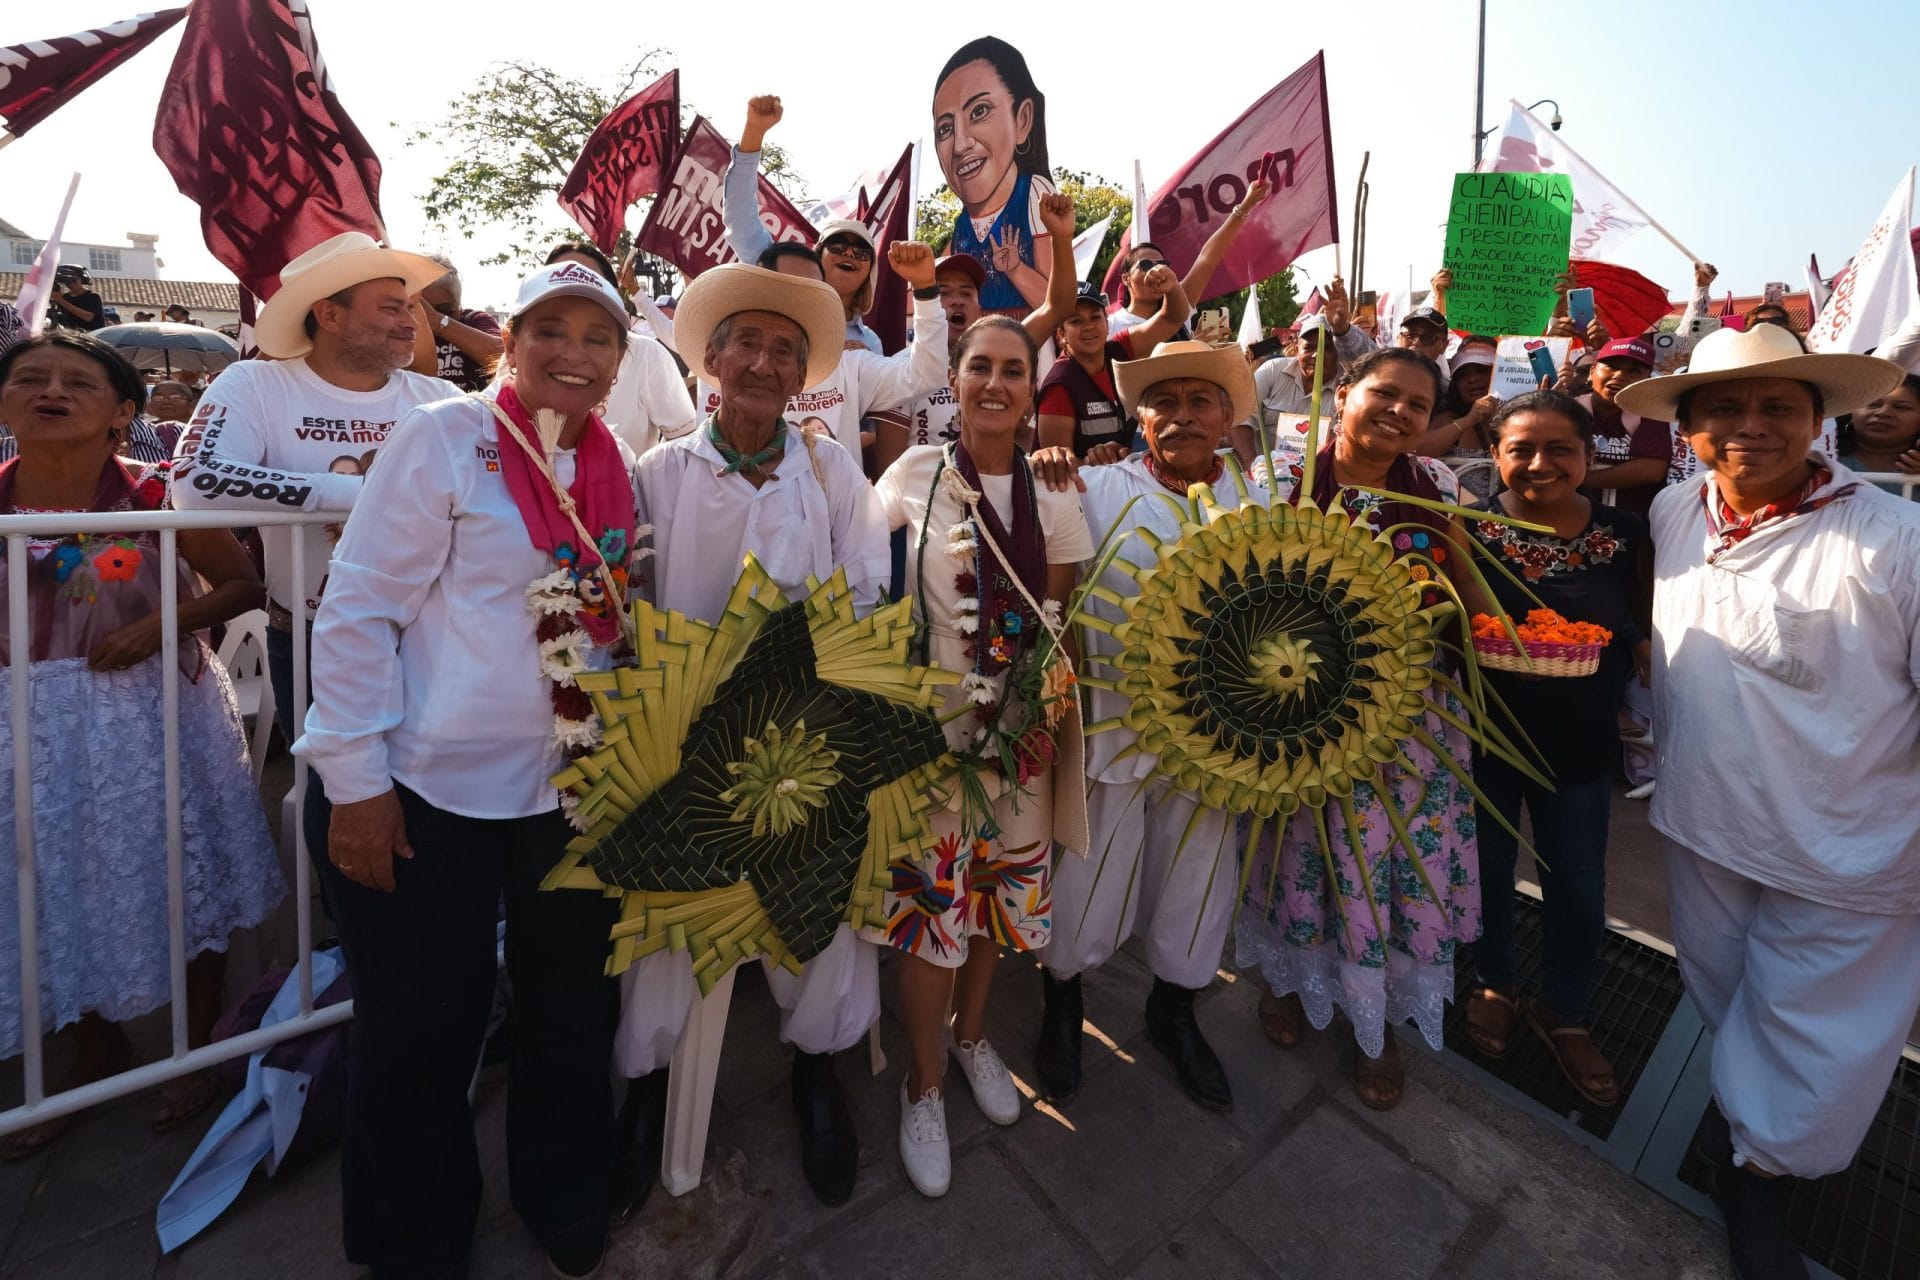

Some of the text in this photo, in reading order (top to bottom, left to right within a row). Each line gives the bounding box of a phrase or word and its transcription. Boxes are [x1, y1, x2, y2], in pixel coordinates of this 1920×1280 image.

[1460, 175, 1567, 202] CLAUDIA
[1446, 247, 1561, 266] LA ASOCIACION
[1502, 264, 1514, 272] DE
[1493, 285, 1550, 299] MEXICANA
[798, 393, 844, 412] morena
[303, 416, 347, 430] ESTE
[295, 427, 352, 443] VOTA
[193, 473, 312, 507] Rocío
